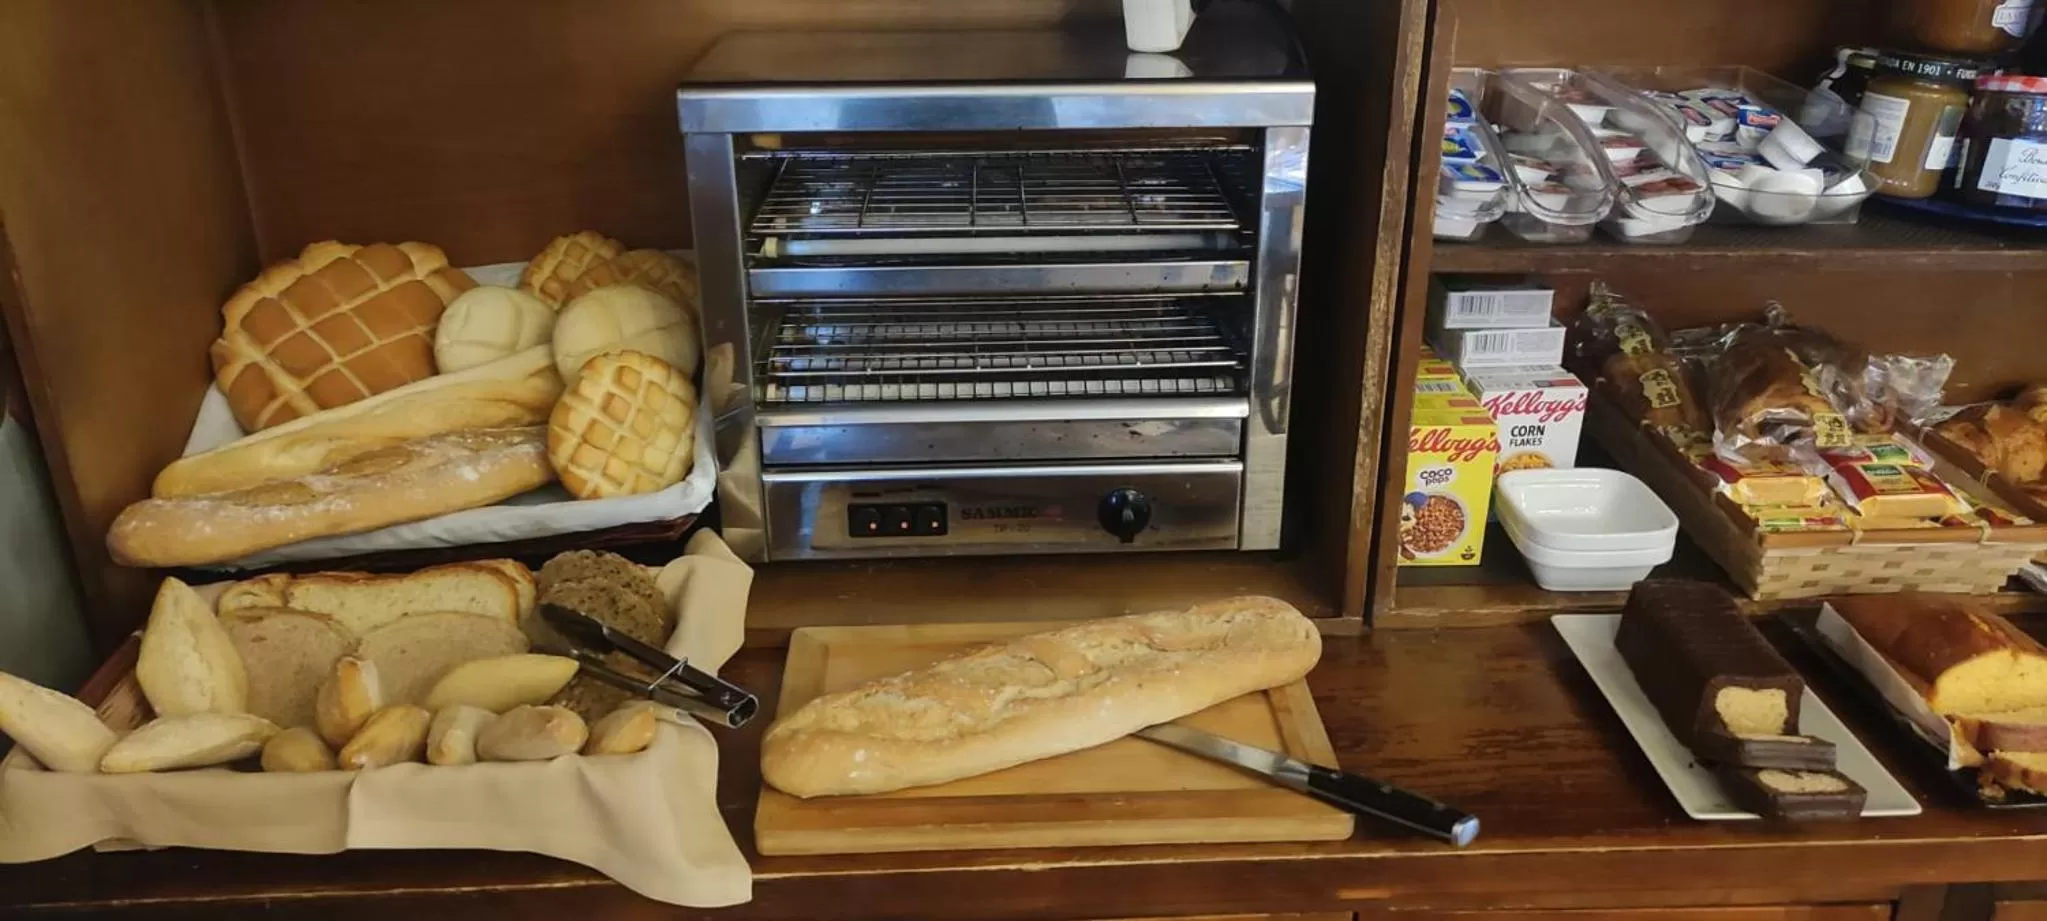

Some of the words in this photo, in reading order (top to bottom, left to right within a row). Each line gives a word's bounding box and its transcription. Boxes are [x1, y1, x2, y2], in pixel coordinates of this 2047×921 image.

[1901, 58, 1915, 71] EN
[1917, 62, 1941, 77] 1901
[1482, 390, 1587, 423] Kellogg's
[1510, 425, 1546, 438] CORN
[1408, 427, 1502, 462] ellogg's
[1509, 437, 1543, 448] FLAKES
